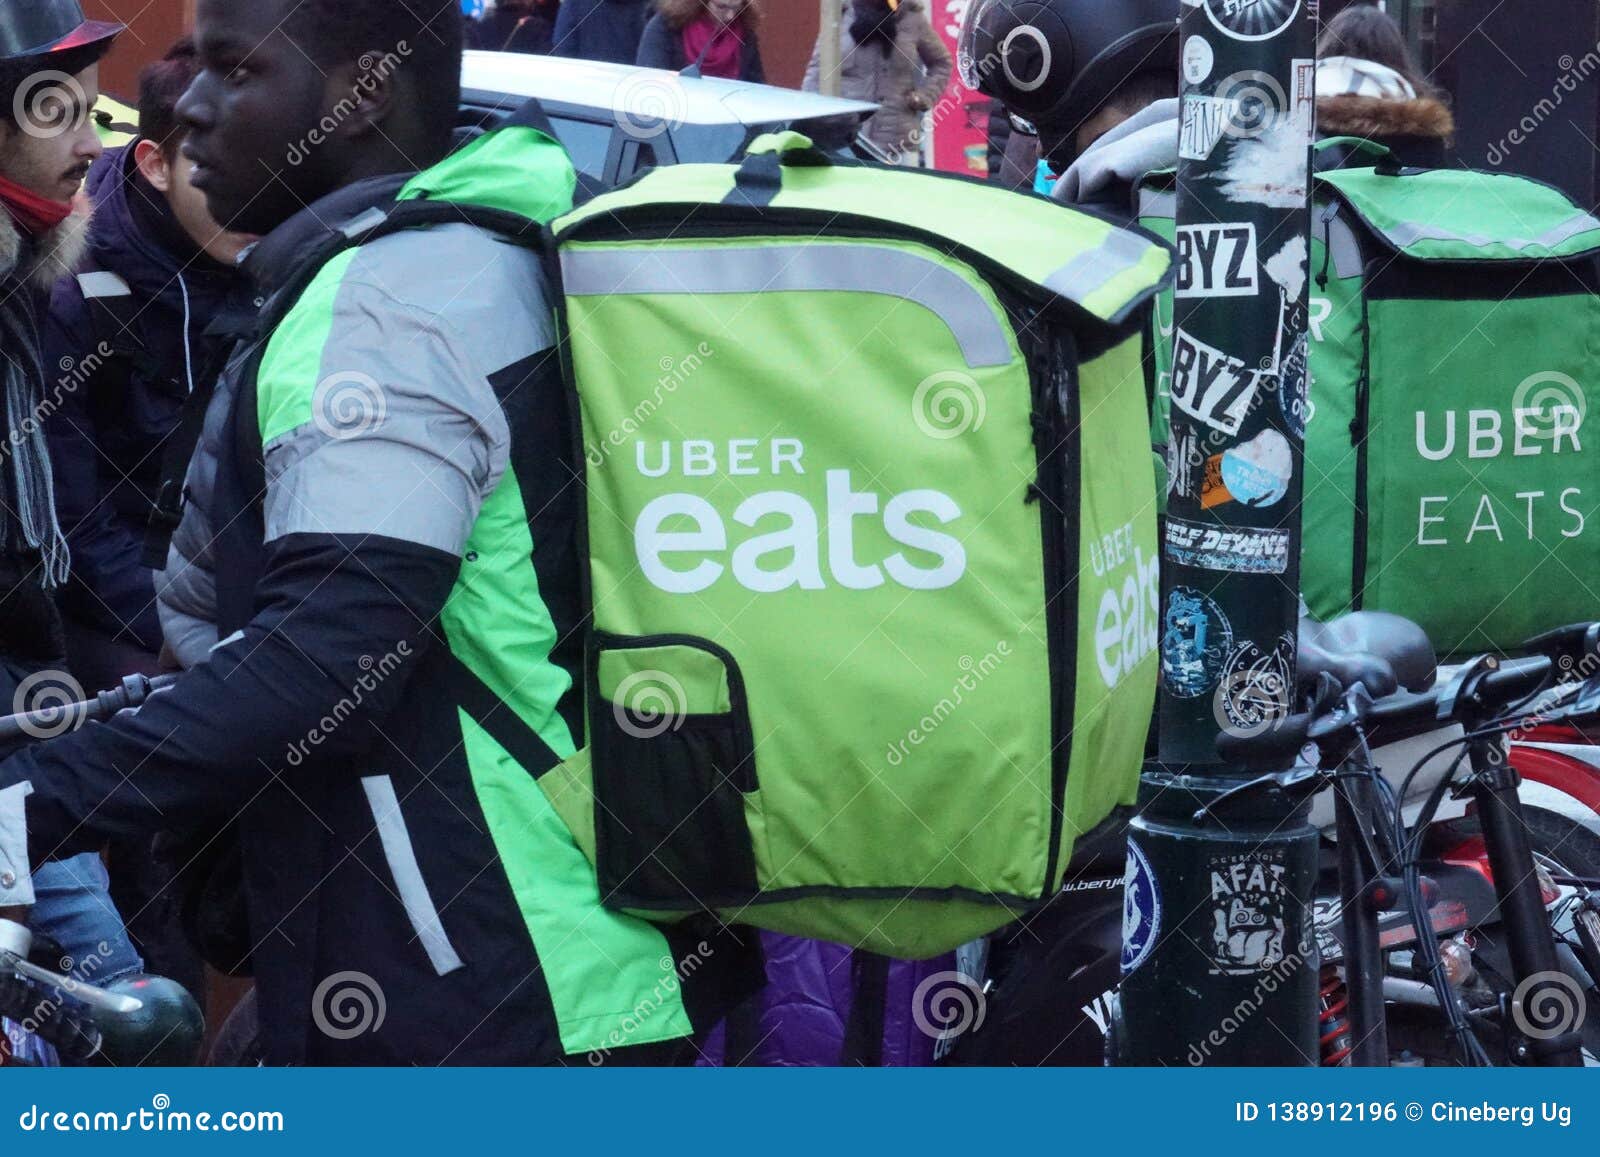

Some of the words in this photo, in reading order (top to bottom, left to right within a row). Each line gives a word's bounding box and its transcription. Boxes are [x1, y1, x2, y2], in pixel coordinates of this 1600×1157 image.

[1175, 228, 1253, 291] BYZ
[1172, 337, 1256, 422] BYZ
[635, 437, 806, 478] UBER
[1416, 404, 1582, 461] UBER
[634, 469, 966, 594] eats
[1418, 487, 1584, 545] EATS
[1090, 523, 1134, 577] UBER
